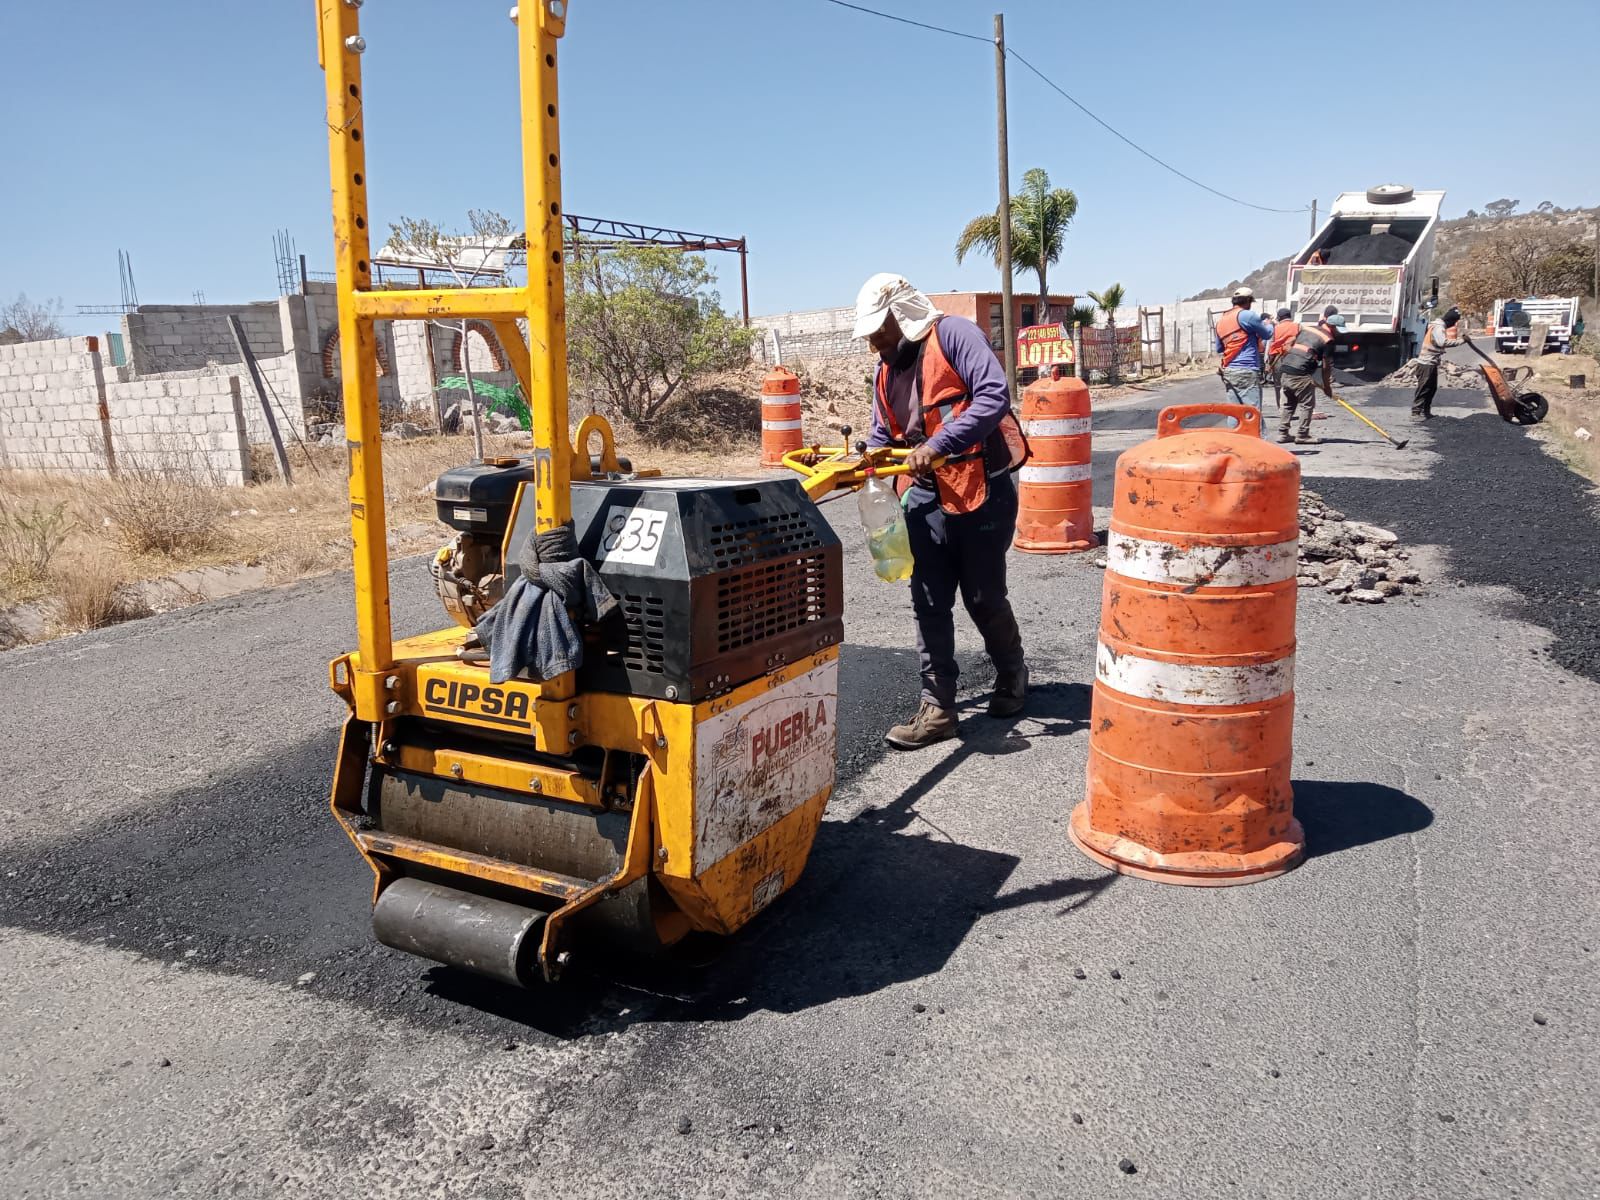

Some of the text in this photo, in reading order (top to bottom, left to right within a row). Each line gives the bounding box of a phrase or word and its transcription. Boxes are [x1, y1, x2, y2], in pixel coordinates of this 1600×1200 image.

[1343, 297, 1358, 305] del
[1360, 297, 1392, 305] Estado
[1348, 289, 1374, 297] cargo
[1376, 287, 1391, 295] del
[1020, 340, 1072, 365] LOTES
[603, 514, 663, 552] 835
[425, 678, 529, 719] CIPSA
[752, 699, 827, 768] PUEBLA
